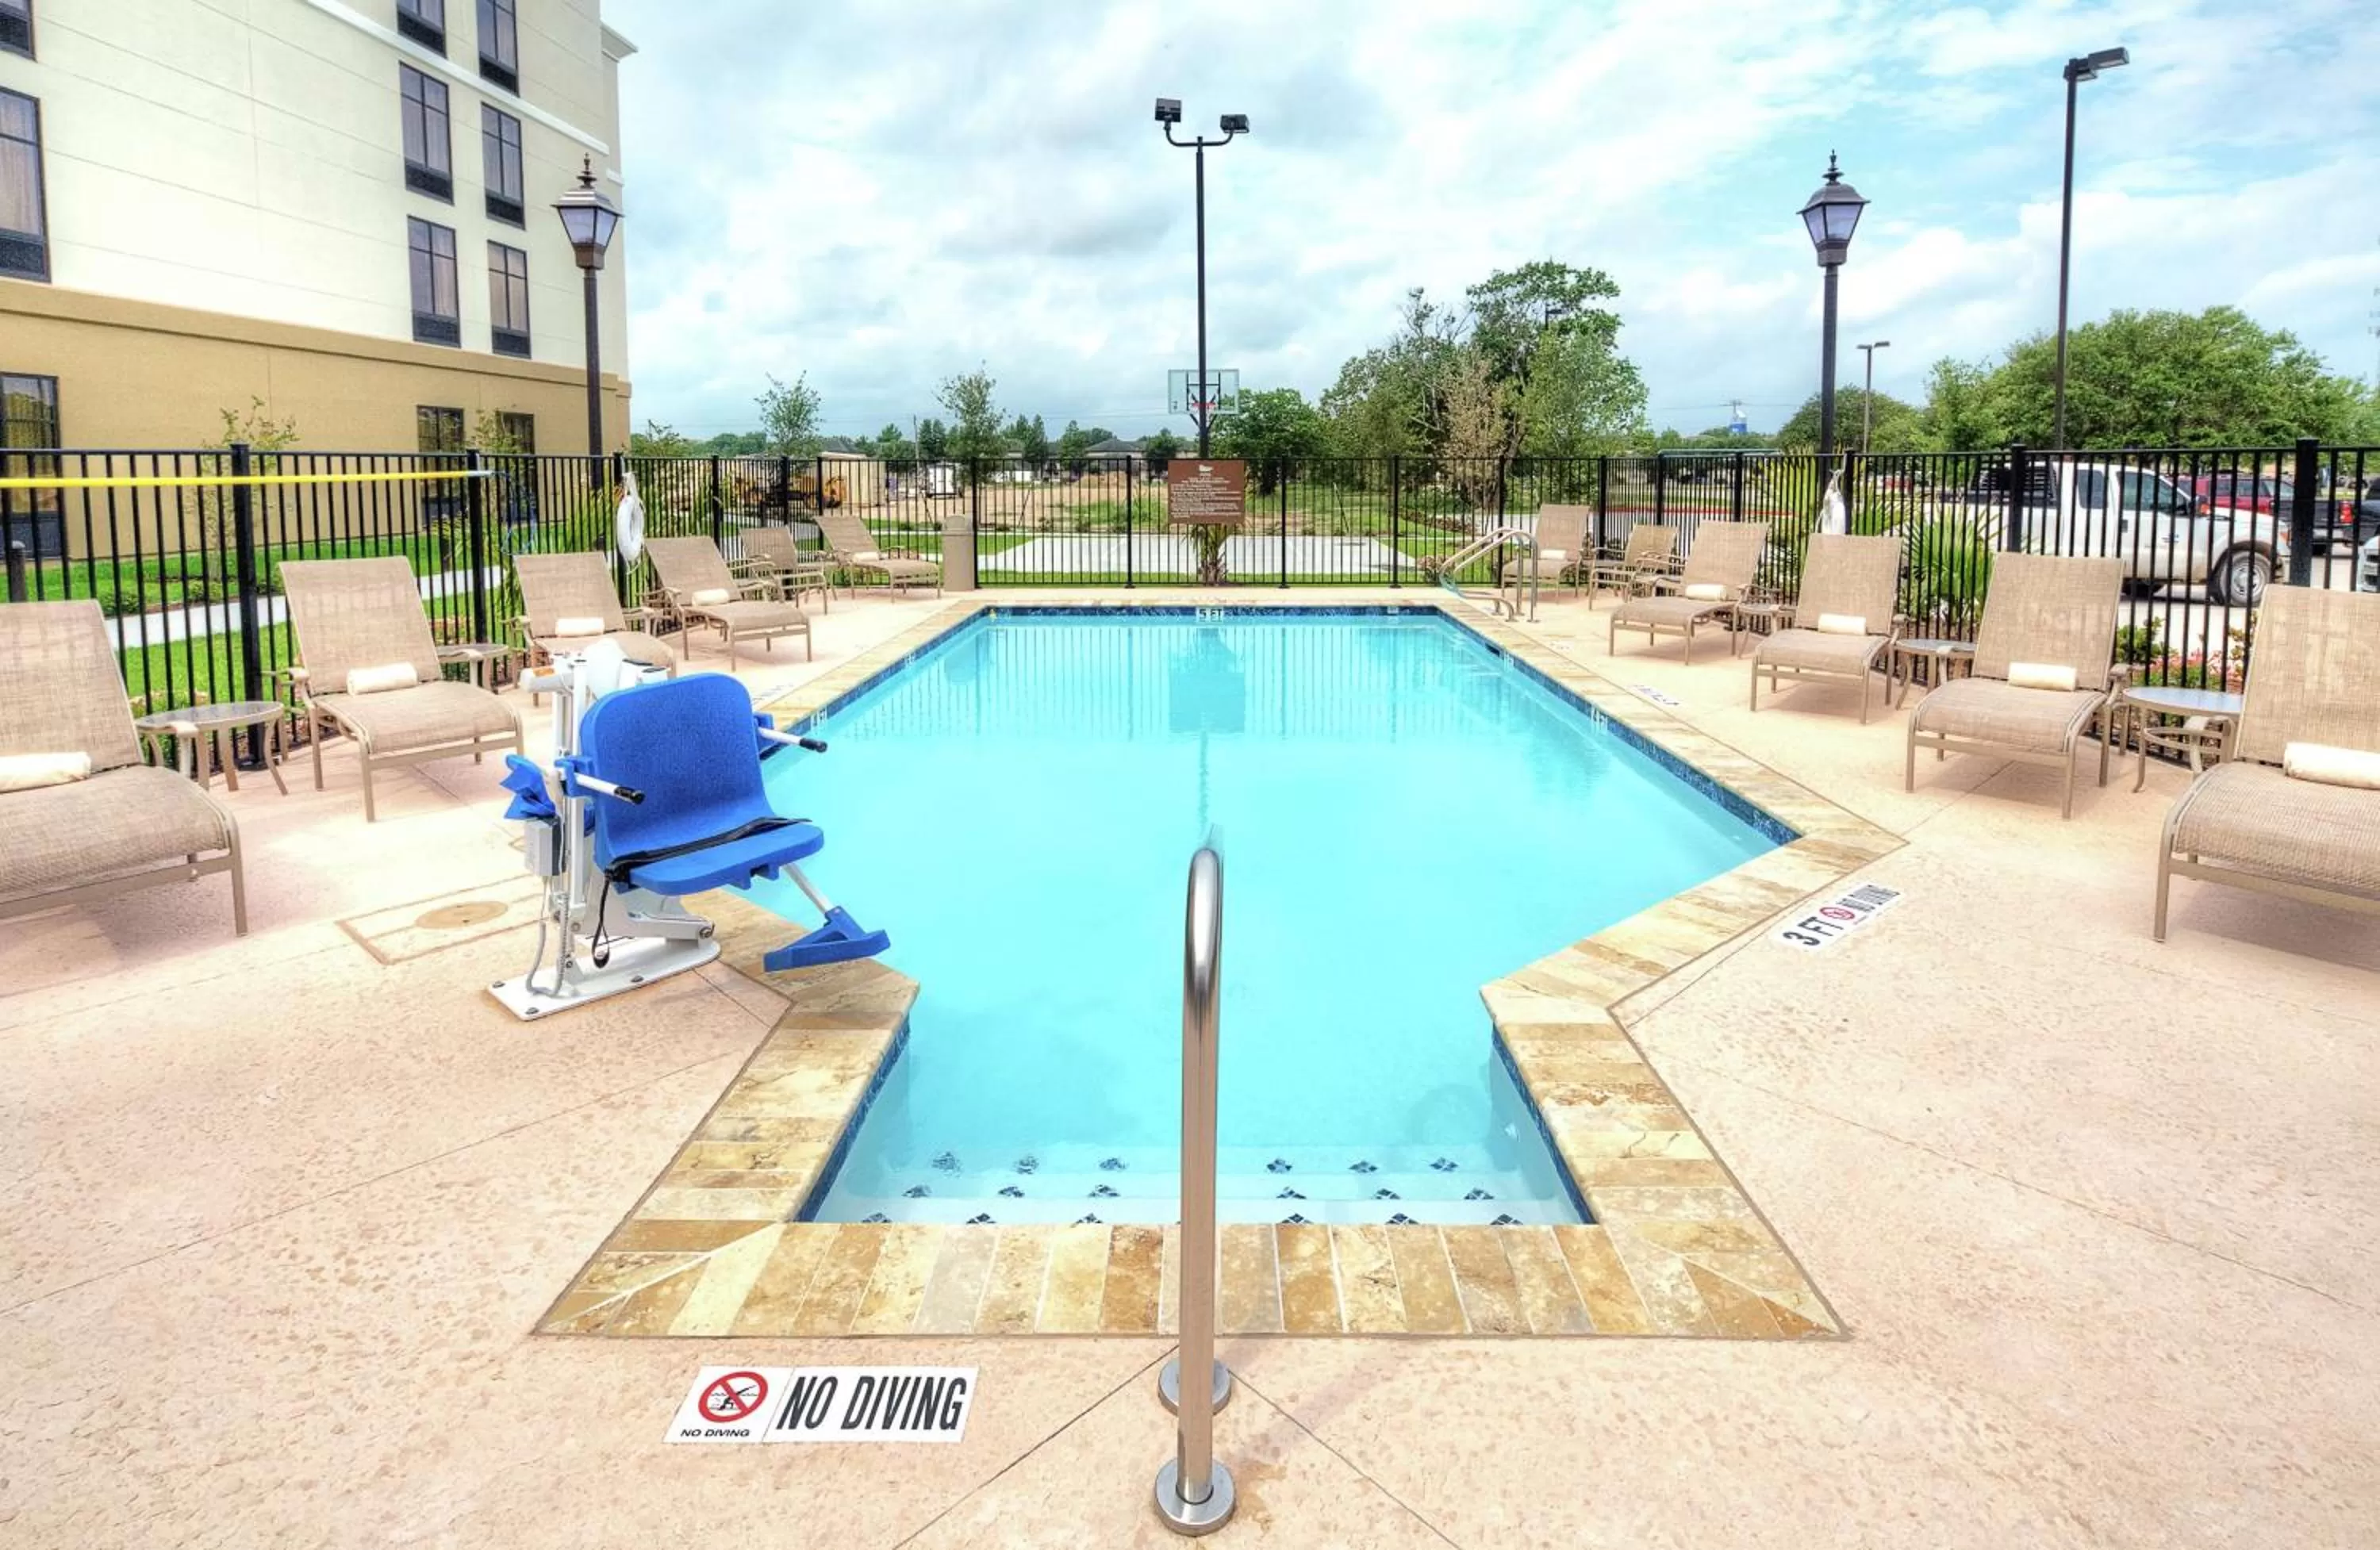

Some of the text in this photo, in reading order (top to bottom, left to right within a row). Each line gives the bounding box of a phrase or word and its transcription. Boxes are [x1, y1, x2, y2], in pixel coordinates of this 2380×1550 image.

[1797, 916, 1844, 937] FT
[1782, 931, 1821, 946] 3
[776, 1376, 967, 1430] NO DIVING
[680, 1429, 750, 1437] NO DIVING
